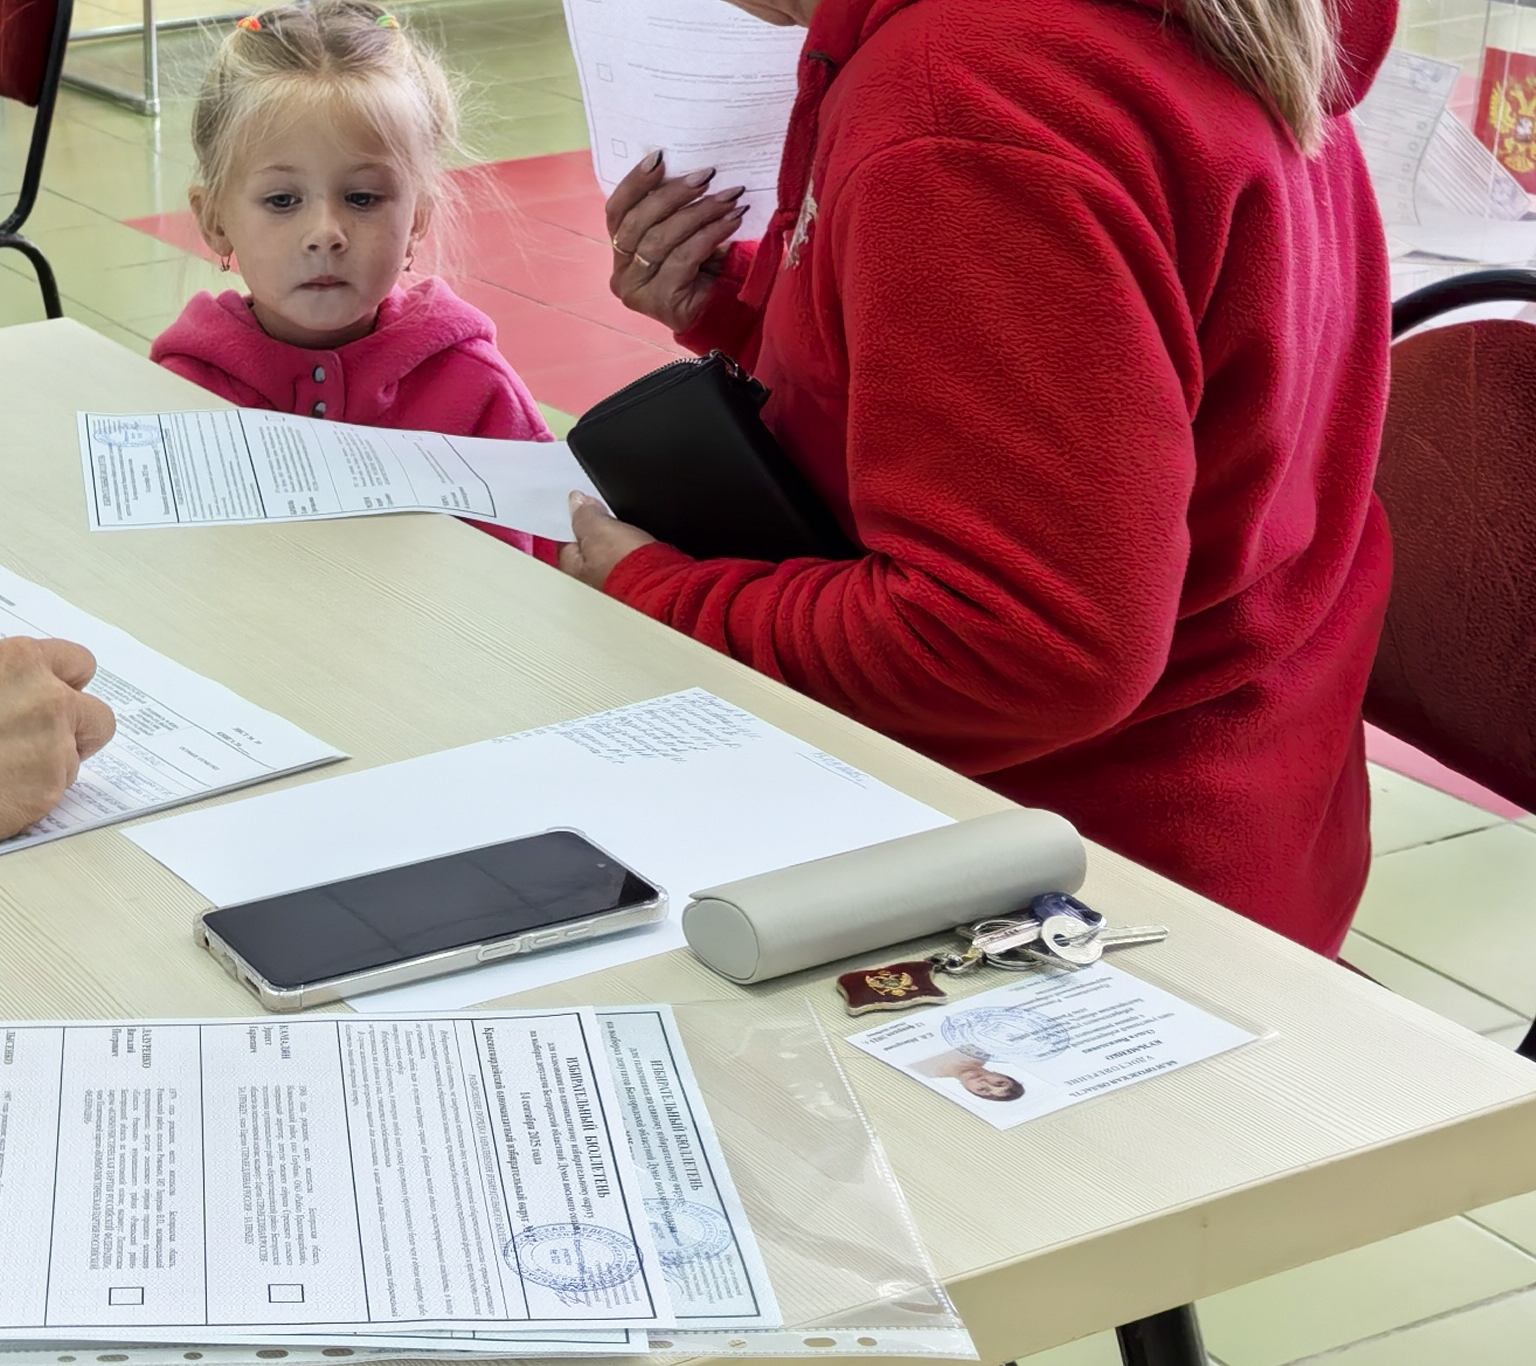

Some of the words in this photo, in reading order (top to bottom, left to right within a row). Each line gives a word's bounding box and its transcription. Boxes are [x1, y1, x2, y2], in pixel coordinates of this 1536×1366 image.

[564, 1056, 599, 1131] ИЗБИРАТЕЛЬНЫЙ
[583, 1135, 613, 1198] БЮЛЛЕТЕНЬ
[649, 1059, 687, 1132] ИЗБИРАТЕЛЬНЫЙ
[673, 1134, 705, 1190] БЮЛЛЕТЕНЬ
